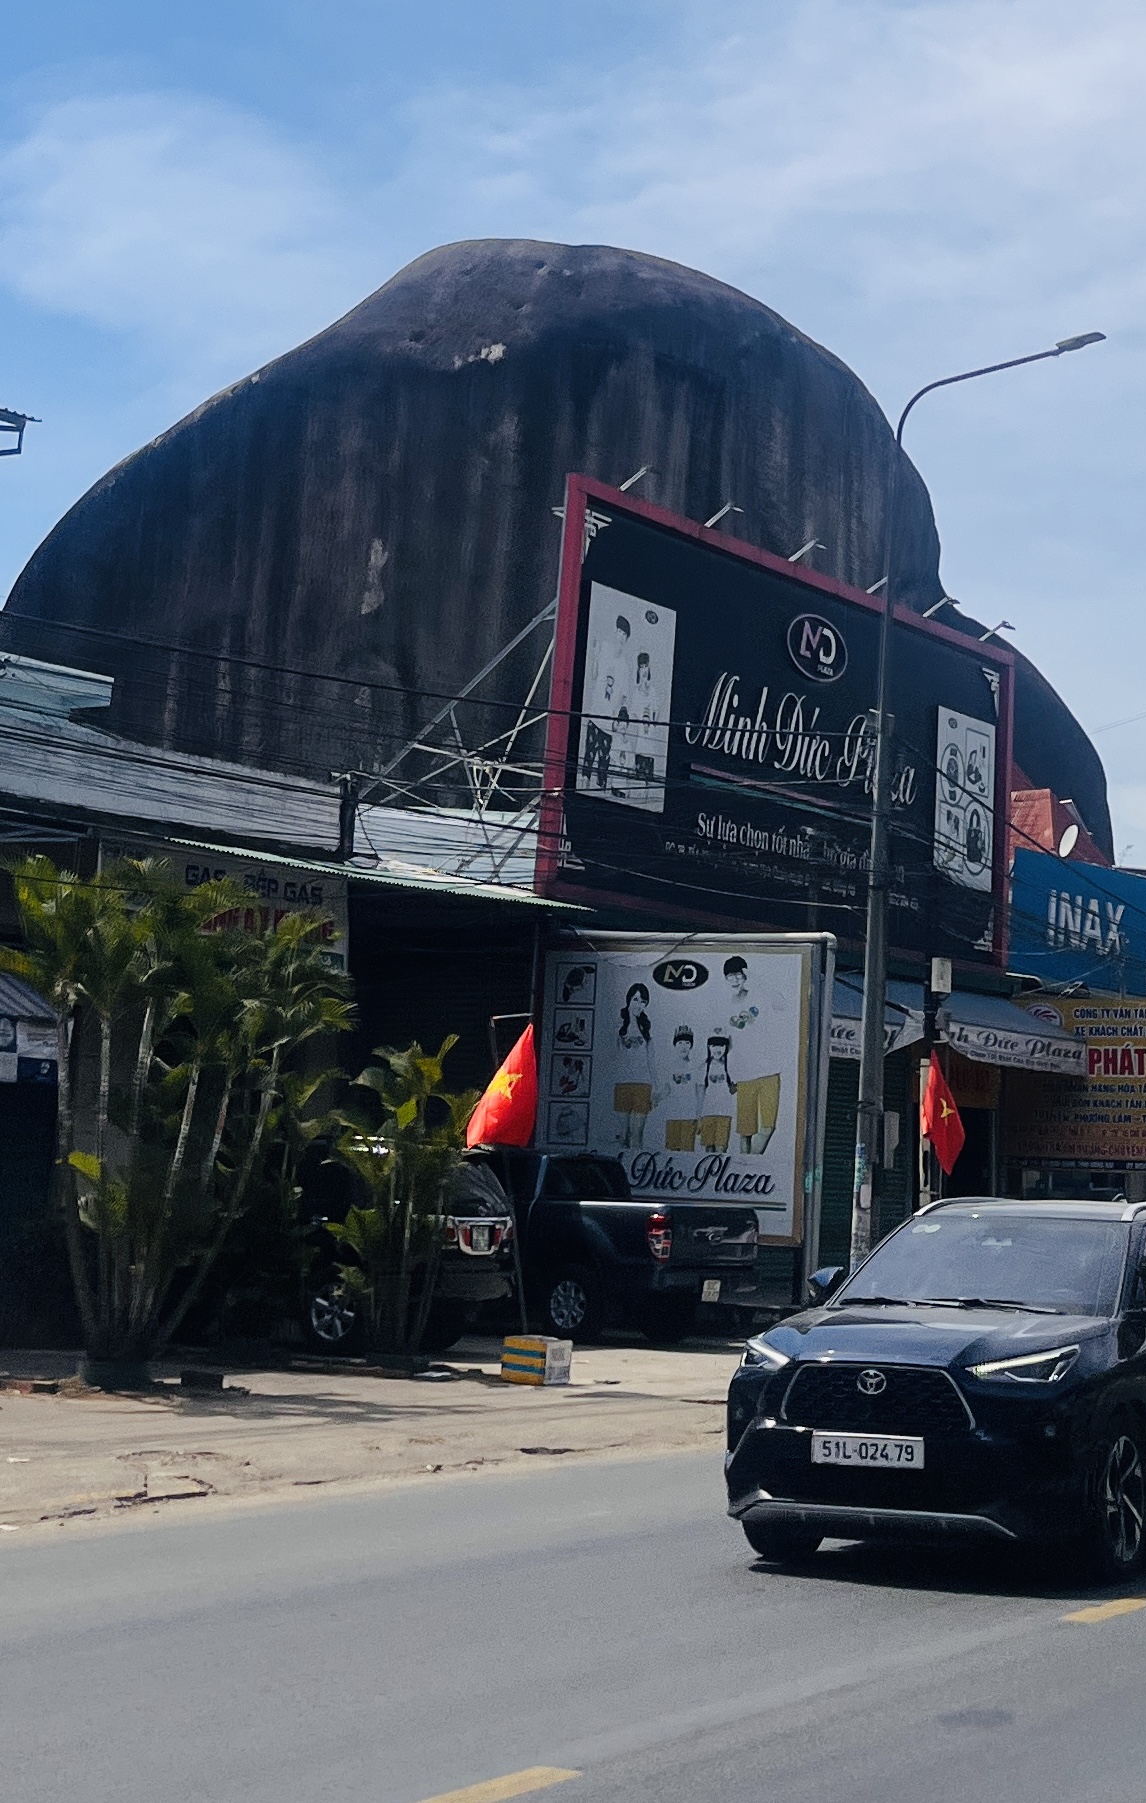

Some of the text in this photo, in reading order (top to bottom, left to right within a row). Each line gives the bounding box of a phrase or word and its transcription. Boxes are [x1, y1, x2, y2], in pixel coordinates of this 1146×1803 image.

[685, 671, 770, 764] Minh
[773, 692, 832, 780] Đức
[698, 812, 716, 845] Sự
[718, 814, 737, 849] lựa
[739, 822, 769, 855] chọn
[771, 825, 788, 855] tốt
[283, 881, 324, 905] GAS
[1046, 889, 1126, 956] INAX
[1101, 1009, 1112, 1019] TY
[1074, 1026, 1086, 1037] XE
[1026, 1039, 1083, 1060] Plaza
[630, 1151, 776, 1195] Đức Plaza
[822, 1440, 914, 1463] 51L-024.79
